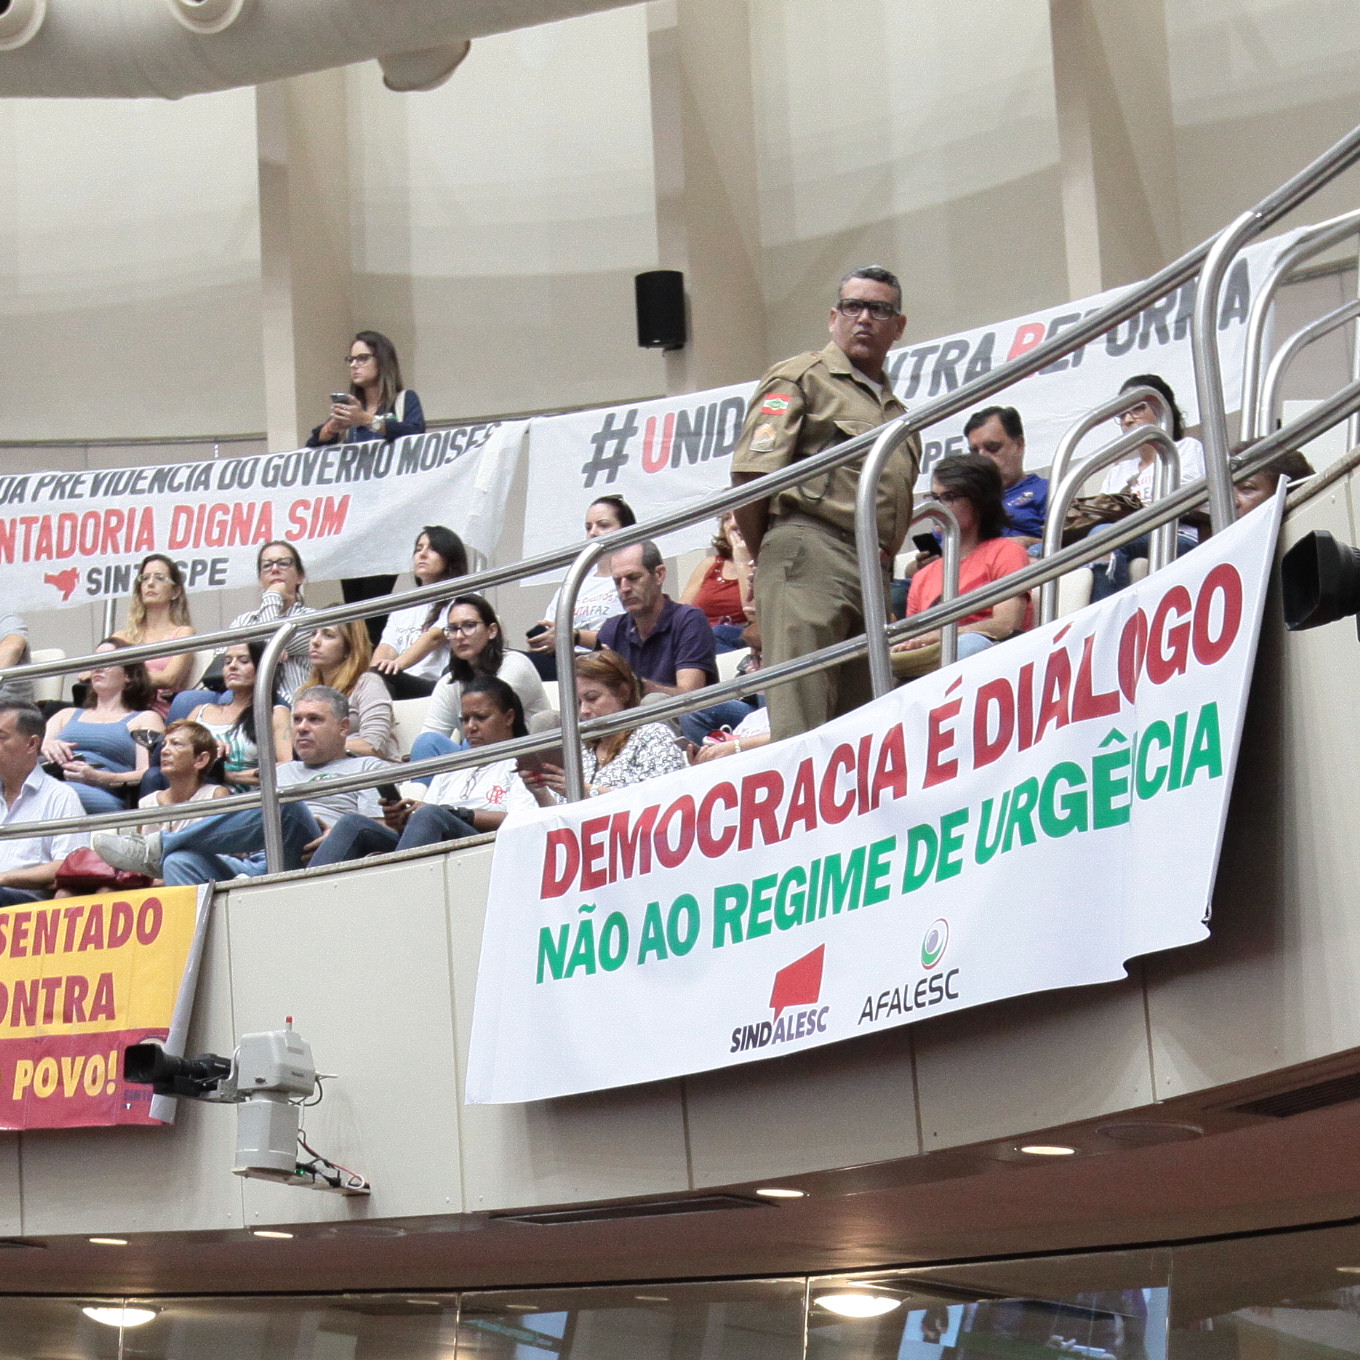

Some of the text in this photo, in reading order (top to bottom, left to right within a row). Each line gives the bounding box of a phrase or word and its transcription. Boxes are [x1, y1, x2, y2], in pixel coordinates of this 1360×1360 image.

[216, 457, 261, 490] DO
[260, 441, 393, 487] GOVERNO
[396, 421, 502, 476] MOISES
[581, 396, 745, 488] #UNID
[168, 499, 272, 551] DIGNA
[285, 494, 353, 541] SIM
[86, 557, 230, 596] SINSPE
[573, 606, 589, 617] UTA
[540, 722, 908, 900] DEMOCRACIA
[922, 674, 963, 789] É
[973, 563, 1243, 770] DIÁLOGO
[536, 701, 1223, 985] NÃO AO REGIME DE URGÊCIA
[730, 968, 960, 1053] SINDALESC AFALESC
[13, 1050, 118, 1101] POVO!
